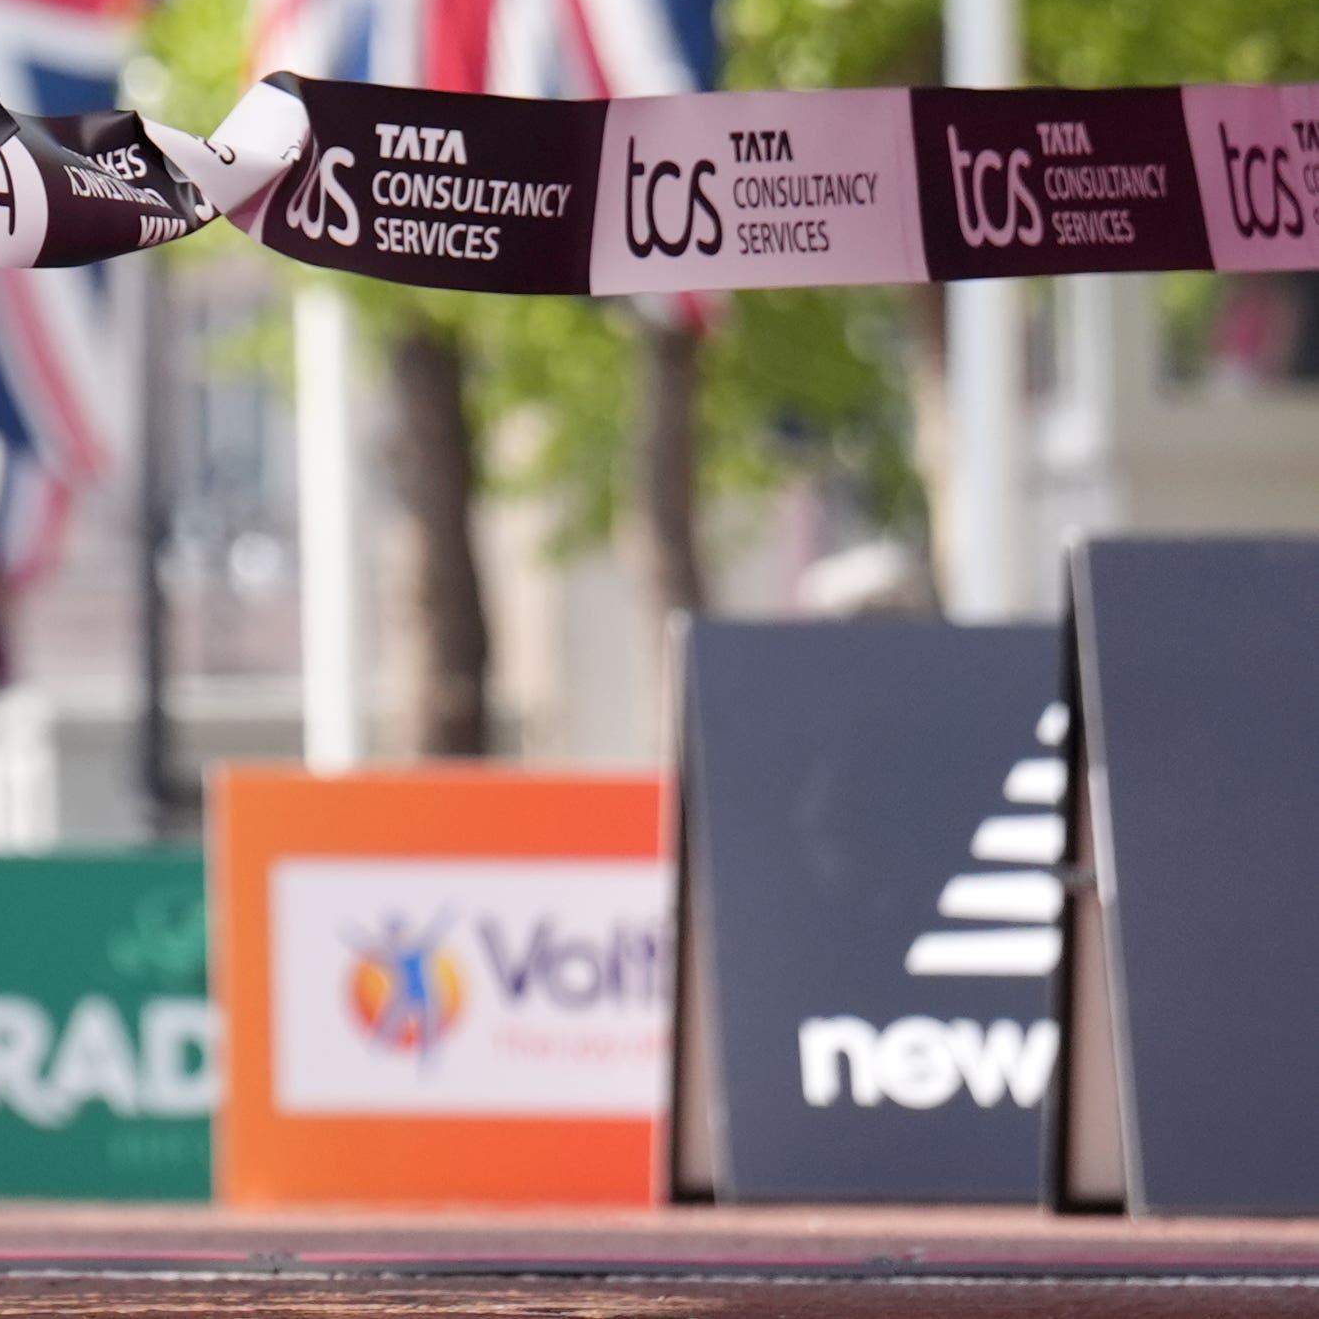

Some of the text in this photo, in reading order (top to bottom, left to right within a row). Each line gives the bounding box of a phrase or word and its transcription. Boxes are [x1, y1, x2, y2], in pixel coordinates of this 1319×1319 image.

[375, 123, 468, 165] TATA
[729, 130, 793, 163] TATA
[1036, 121, 1093, 156] TATA
[372, 170, 572, 218] CONSULTANCY
[625, 134, 723, 259] tcs
[733, 172, 878, 209] CONSULTANCY
[947, 124, 1044, 248] tcs
[1044, 165, 1166, 201] CONSULTANCY
[1219, 121, 1304, 238] tcs
[373, 217, 500, 261] SERVICES
[737, 220, 830, 255] SERVICES
[1052, 210, 1136, 244] SERVICES
[798, 1015, 1060, 1109] new
